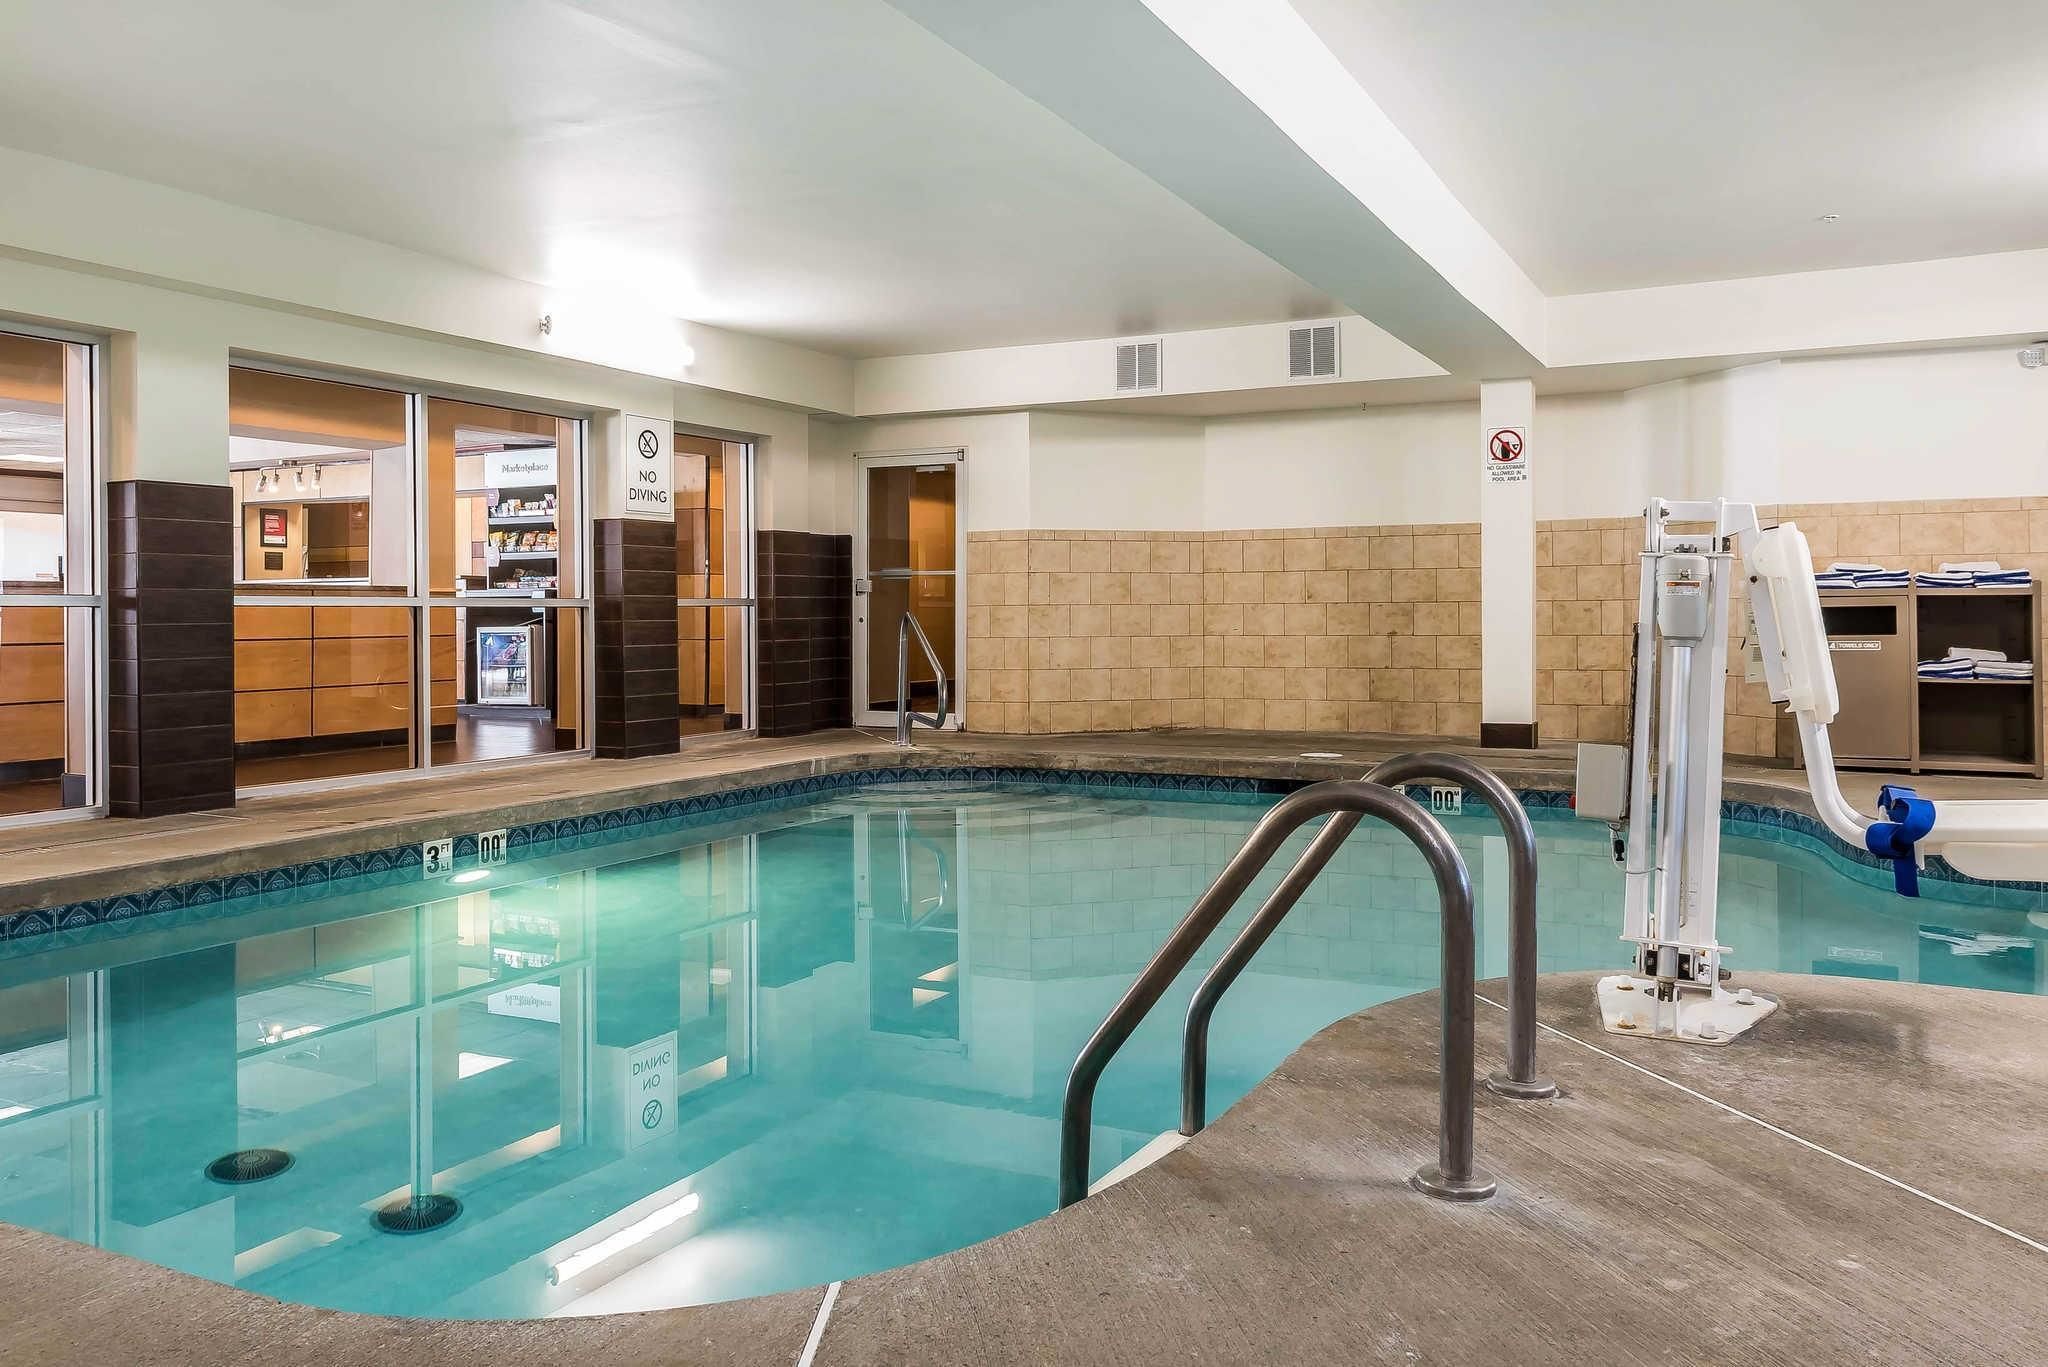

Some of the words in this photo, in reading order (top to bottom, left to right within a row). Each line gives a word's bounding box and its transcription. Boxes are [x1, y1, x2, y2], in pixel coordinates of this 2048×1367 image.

[502, 463, 549, 474] Marketplace
[639, 470, 657, 484] NO
[629, 487, 668, 503] DIVING
[426, 845, 440, 874] 3
[441, 843, 450, 853] FT
